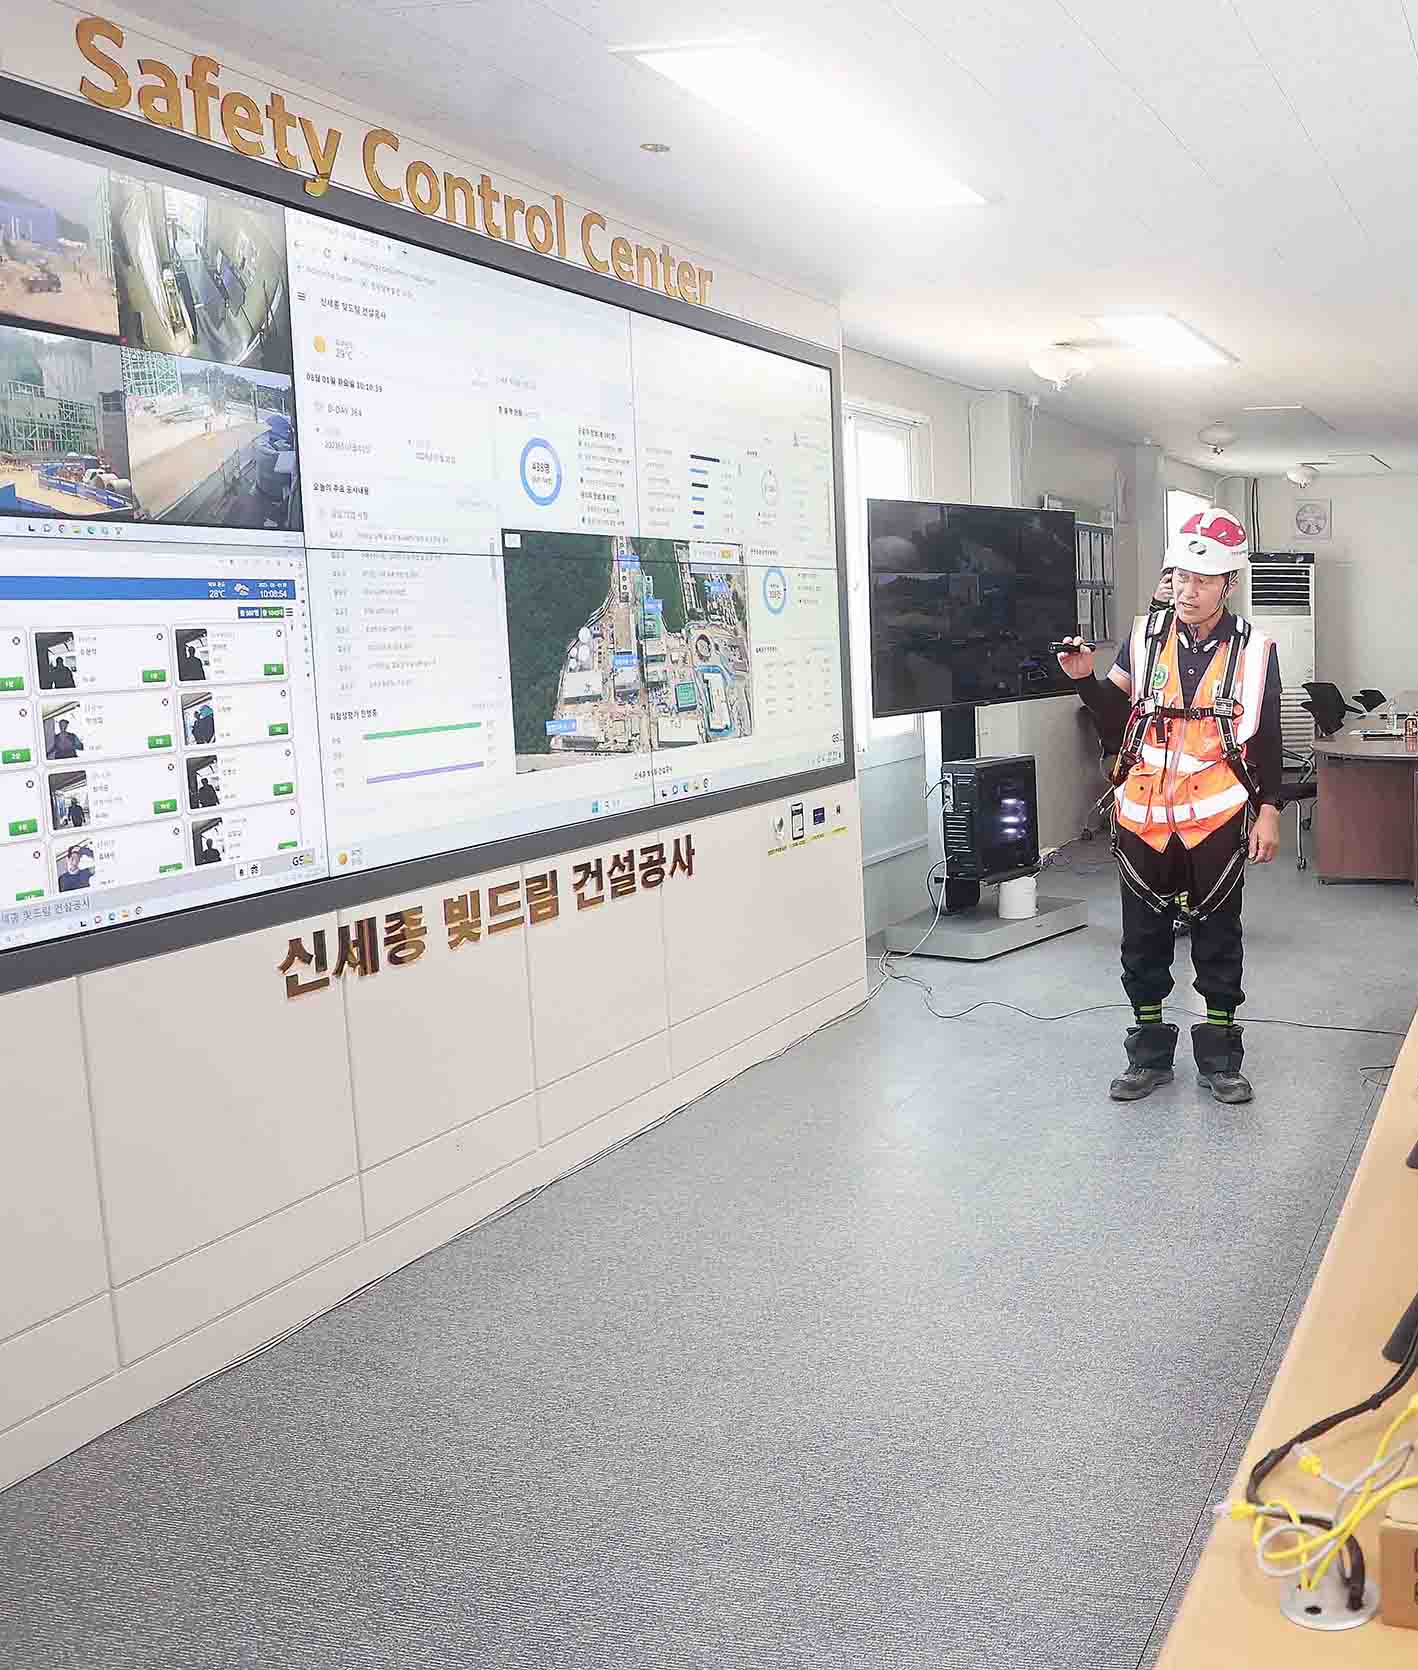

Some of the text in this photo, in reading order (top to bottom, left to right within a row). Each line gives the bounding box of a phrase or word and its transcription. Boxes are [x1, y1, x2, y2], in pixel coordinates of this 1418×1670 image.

[75, 17, 715, 306] Safety Control Center
[276, 906, 429, 1001] 신세종
[443, 869, 561, 951] 빛드림
[571, 833, 696, 912] 건설공사
